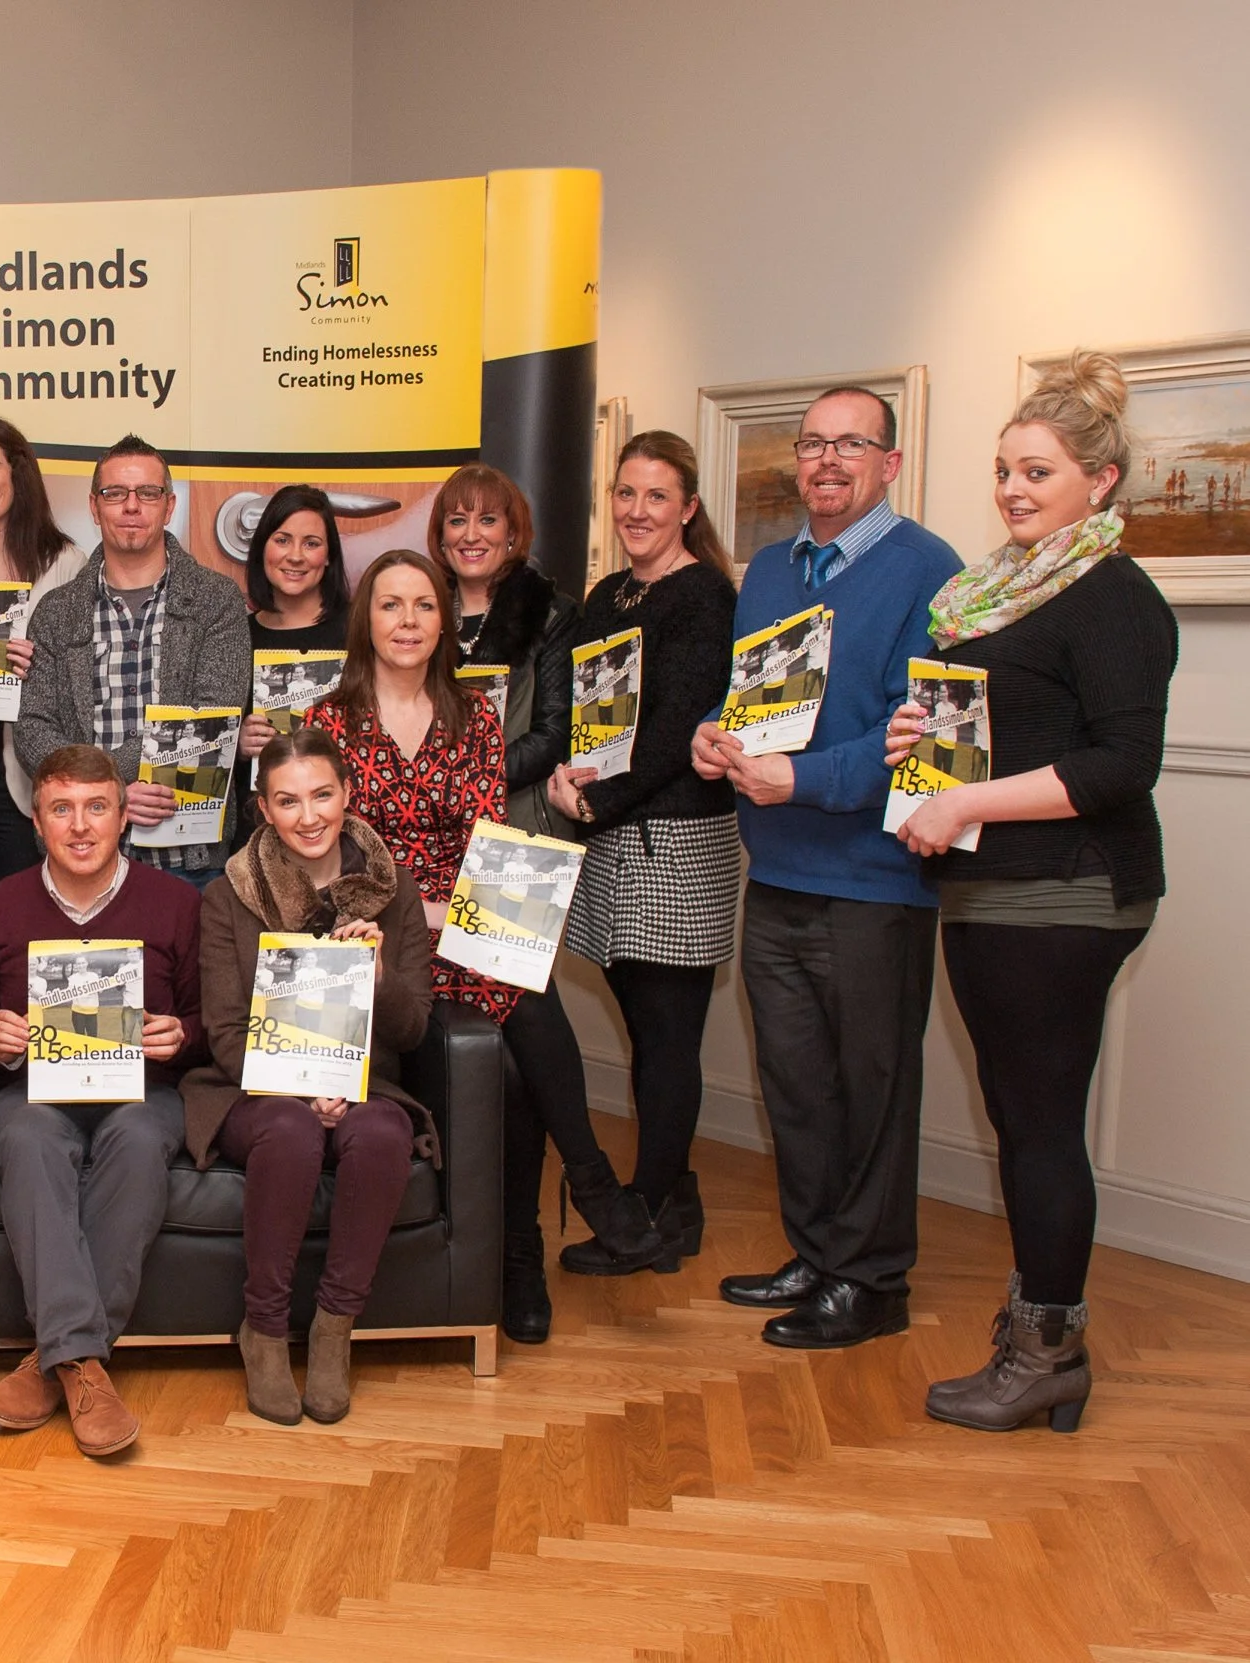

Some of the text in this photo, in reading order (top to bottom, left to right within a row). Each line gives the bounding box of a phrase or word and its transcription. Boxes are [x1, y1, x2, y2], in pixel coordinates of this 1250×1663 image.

[295, 261, 326, 270] Midlands
[296, 272, 389, 311] Simon
[310, 315, 371, 325] Community
[262, 342, 438, 365] Ending Homelessness
[277, 369, 424, 391] Creating Homes
[721, 704, 747, 722] 20
[744, 700, 820, 727] Calendar
[571, 721, 590, 740] 20
[590, 726, 635, 751] Calendar
[895, 770, 920, 797] 15
[450, 894, 480, 915] 20
[451, 908, 480, 935] 15
[475, 922, 558, 954] Calendar
[28, 1025, 57, 1042] 20
[249, 1016, 279, 1034] 20
[33, 1037, 143, 1063] 15 Calendar
[251, 1028, 282, 1055] 15
[278, 1038, 365, 1061] Calendar
